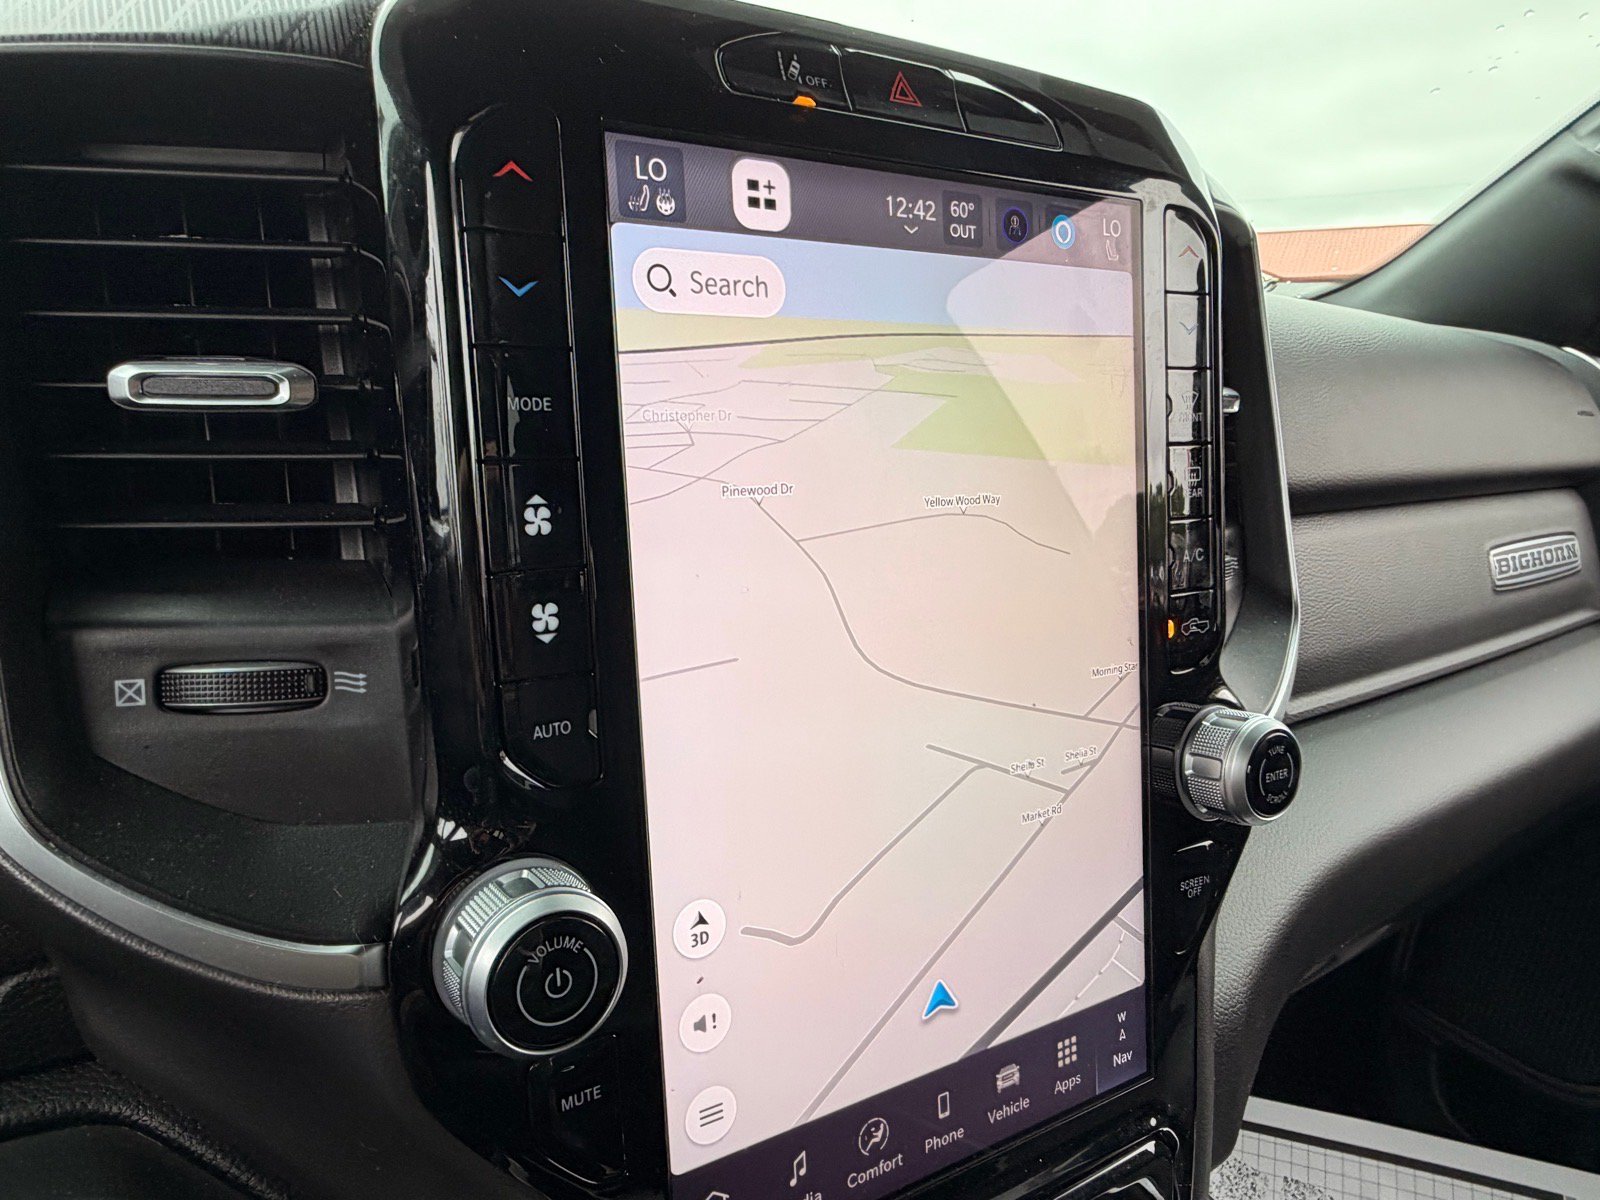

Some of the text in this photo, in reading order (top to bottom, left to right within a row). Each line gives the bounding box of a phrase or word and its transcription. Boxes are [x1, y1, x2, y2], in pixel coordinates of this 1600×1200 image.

[805, 75, 828, 89] OFF
[636, 154, 667, 182] LO
[887, 196, 937, 222] 12:42
[950, 200, 975, 219] 60°
[950, 222, 977, 241] OUT
[1103, 218, 1121, 237] LO
[690, 270, 768, 300] Search
[508, 397, 552, 412] MODE
[642, 409, 732, 424] Christopher Dr
[722, 483, 793, 497] Pinewood Dr
[924, 494, 1001, 508] Yellow Wood Way
[1183, 547, 1204, 562] A/C
[1495, 544, 1578, 577] BIGHORN
[1092, 664, 1123, 677] Morning
[533, 720, 572, 740] AUTO
[1089, 747, 1097, 755] St
[1268, 745, 1285, 757] TUNE
[1036, 759, 1044, 767] St
[1265, 768, 1289, 783] ENTER
[1022, 805, 1062, 823] Market Rd
[1180, 874, 1210, 891] SCREEN
[1187, 886, 1203, 898] OFF
[690, 931, 709, 948] 3D
[527, 935, 584, 965] VOLUME
[1117, 1011, 1126, 1023] W
[1113, 1050, 1132, 1068] Nav
[1054, 1073, 1081, 1095] Apps
[561, 1085, 602, 1112] MUTE
[987, 1096, 1030, 1124] Vehicle
[925, 1127, 965, 1154] Phone
[847, 1153, 903, 1188] Comfort
